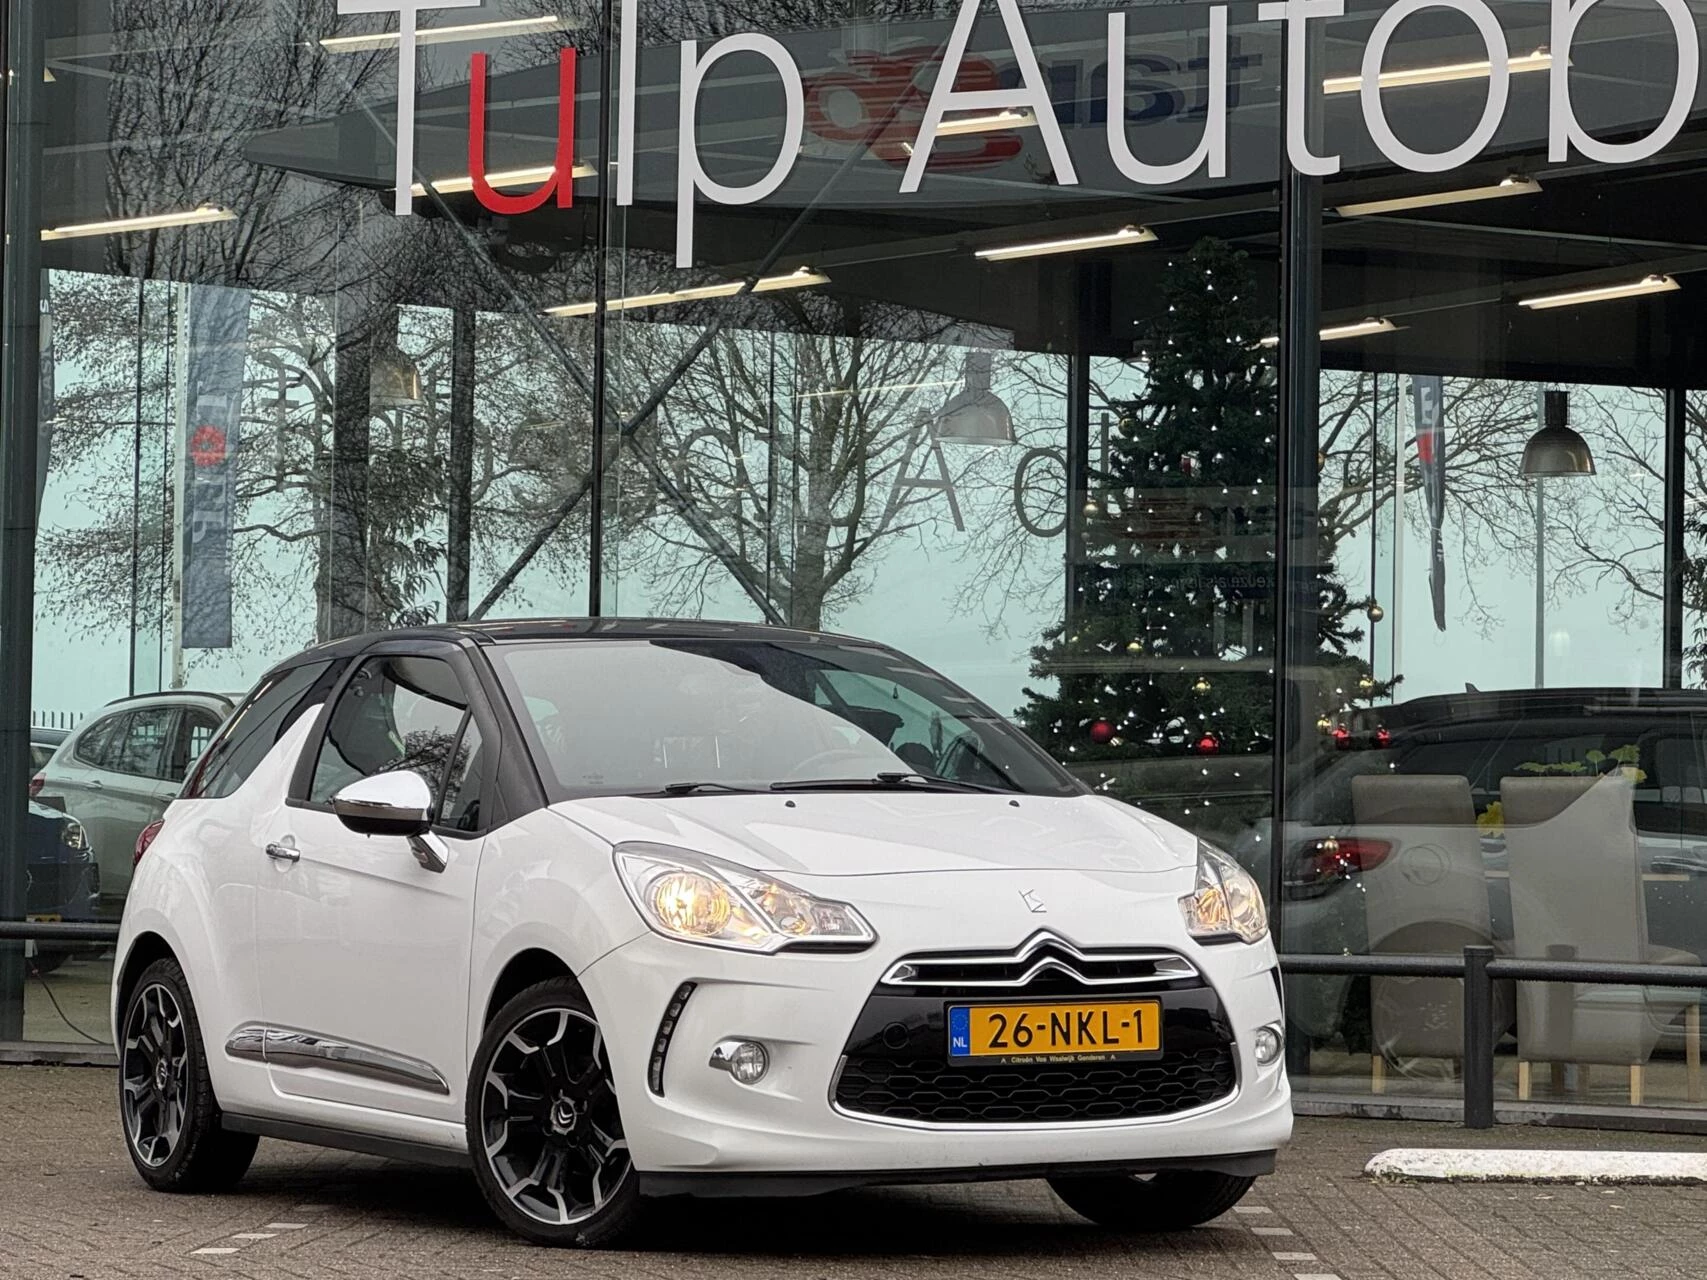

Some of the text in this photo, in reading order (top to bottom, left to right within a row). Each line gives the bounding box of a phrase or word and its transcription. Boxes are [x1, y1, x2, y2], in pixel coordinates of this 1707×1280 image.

[337, 0, 1699, 269] Tulp Autob
[952, 1036, 968, 1048] NL
[988, 1009, 1143, 1049] 26-NKL-1
